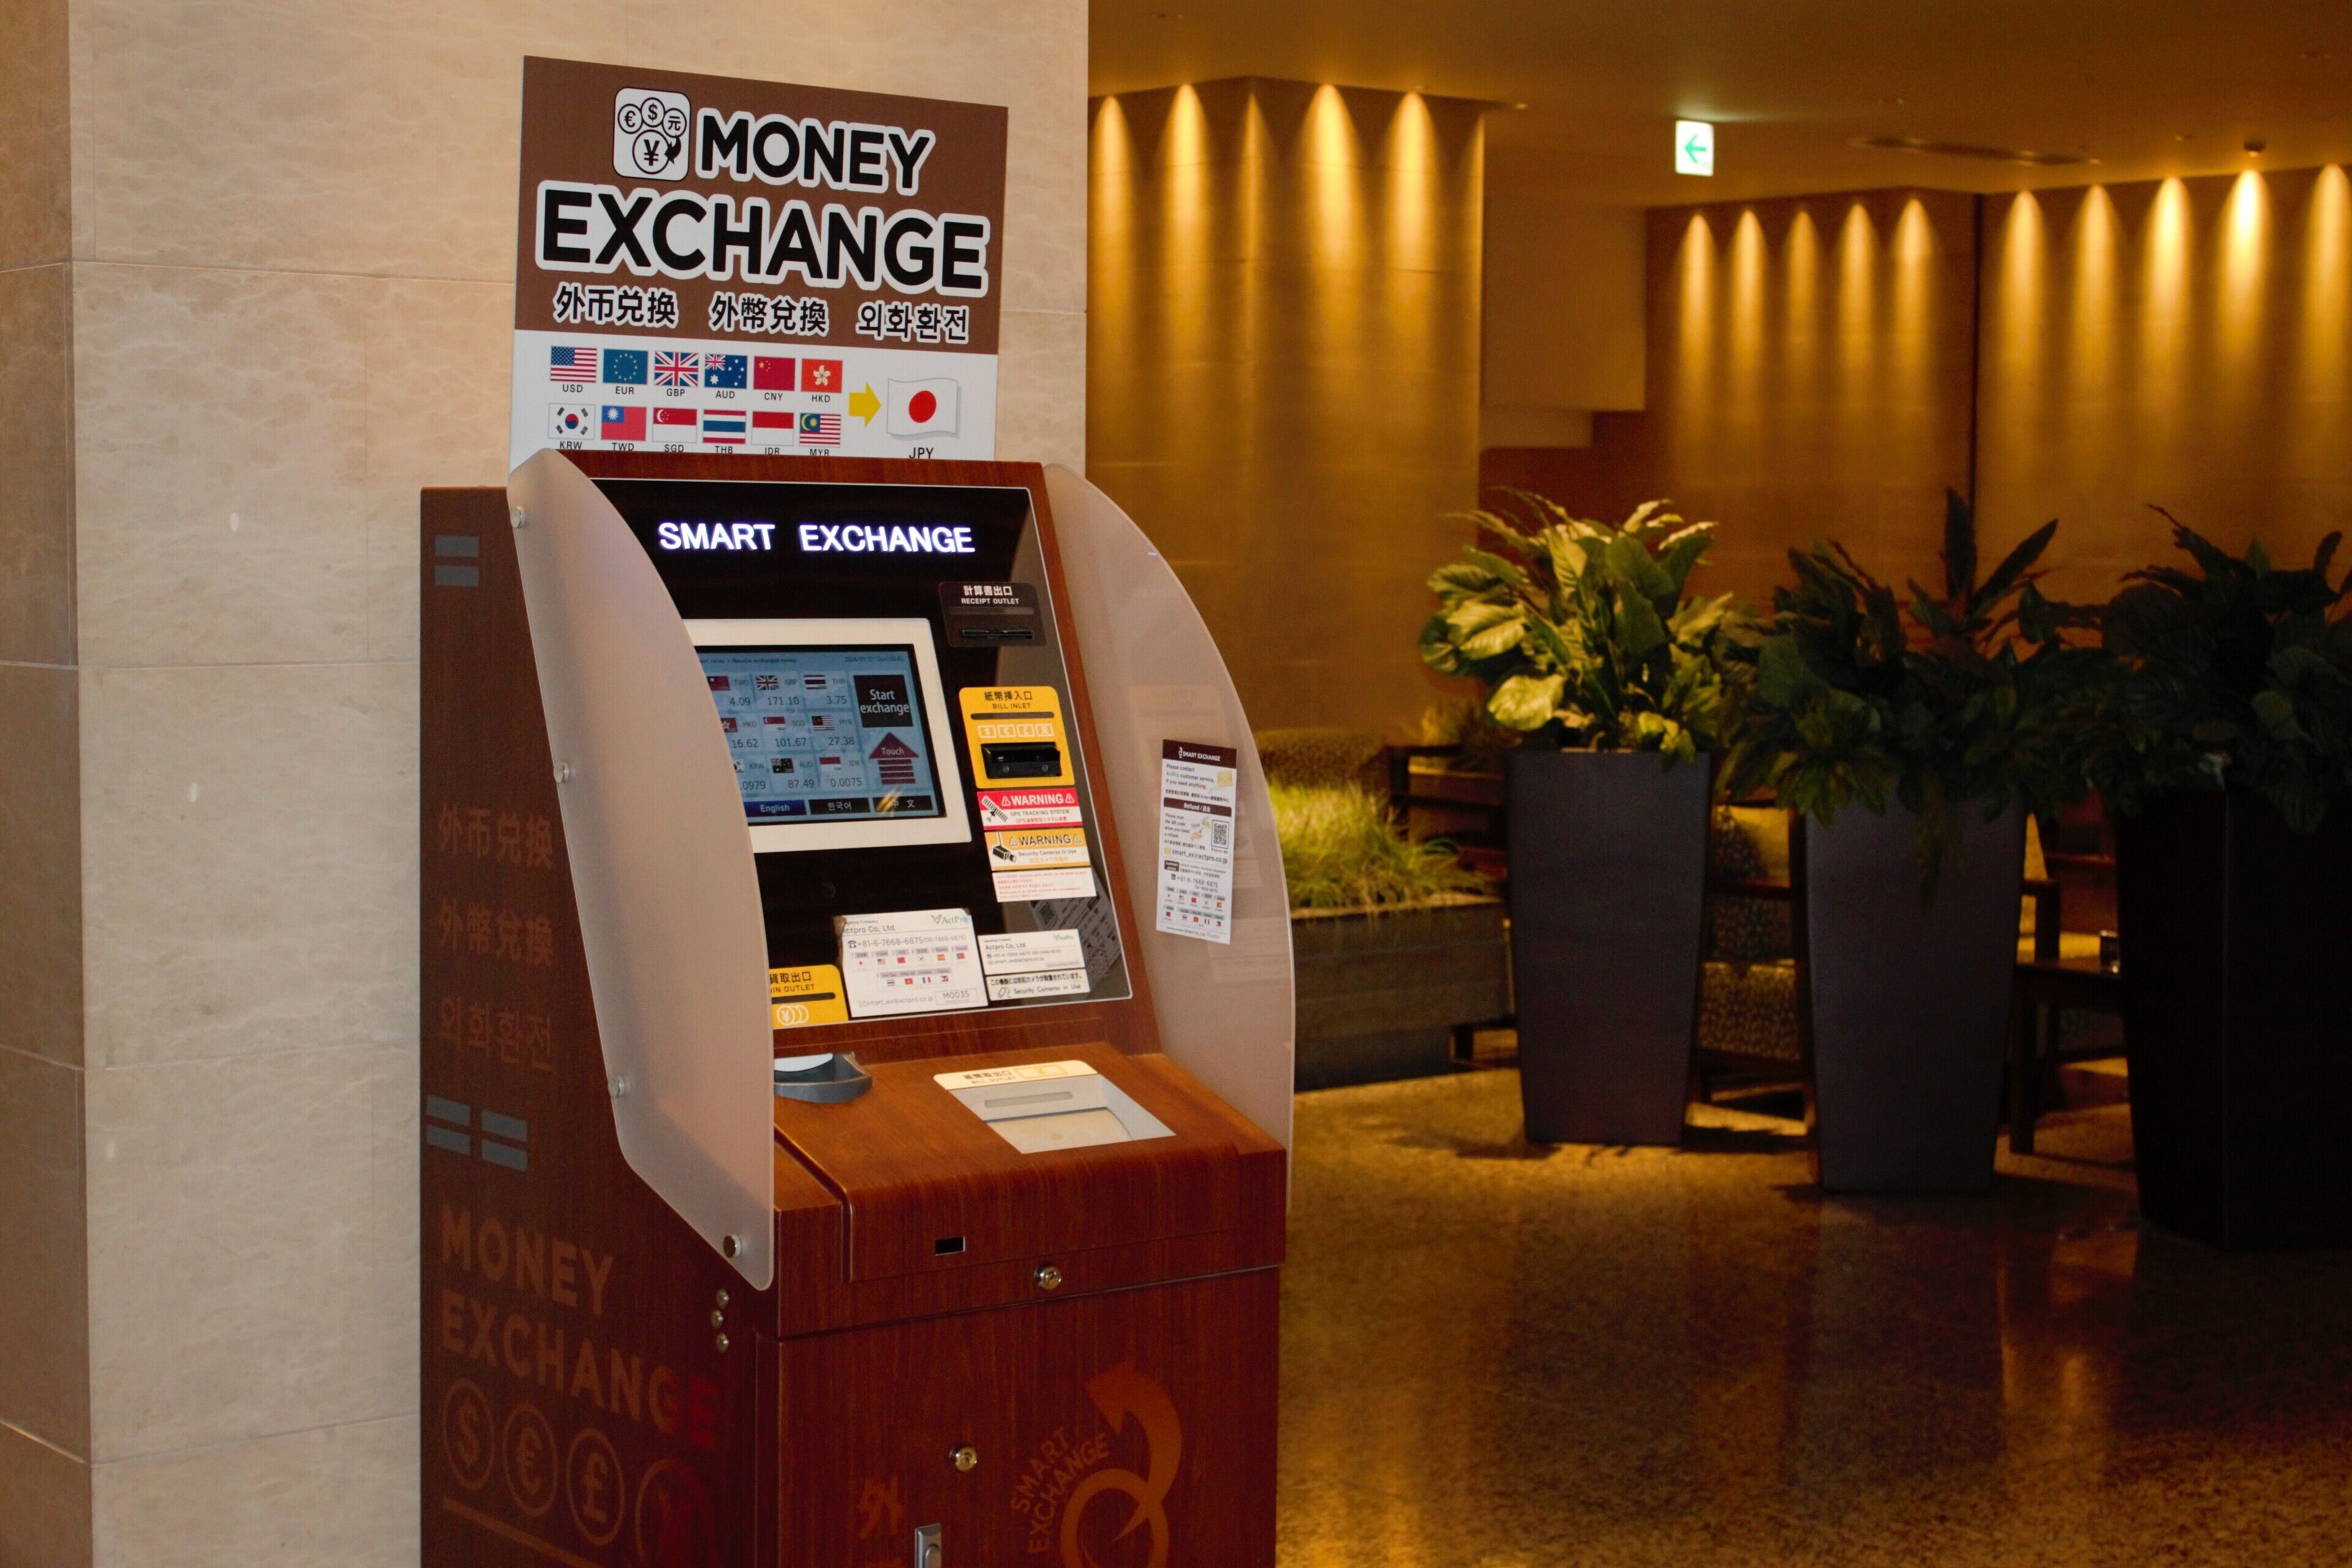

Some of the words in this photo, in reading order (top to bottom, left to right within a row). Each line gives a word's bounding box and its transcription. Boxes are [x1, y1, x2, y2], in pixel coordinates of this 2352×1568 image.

[698, 113, 931, 190] MONEY
[541, 187, 985, 291] EXCHANGE
[557, 285, 676, 326] 外币兑换
[712, 295, 827, 334] 外幣兌換
[858, 304, 967, 341] 외화환전
[562, 384, 583, 393] USD
[615, 386, 634, 395] EUR
[666, 388, 685, 397] GBP
[764, 393, 783, 401] CNY
[559, 441, 582, 450] KRW
[612, 443, 635, 451] TWD
[664, 444, 684, 453] SGD
[764, 447, 780, 456] IDR
[909, 447, 935, 459] JPY
[658, 522, 775, 550] SMART
[798, 524, 976, 553] EXCHANGE
[963, 585, 1012, 596] 計算書出口
[869, 688, 895, 700] Start
[729, 696, 751, 706] 4.09
[767, 696, 800, 706] 171.10
[827, 695, 847, 704] 3.75
[860, 702, 910, 715] exchange
[731, 739, 759, 748] 16.62
[775, 737, 807, 747] 101.67
[829, 736, 855, 746] 27.38
[881, 746, 905, 756] Touch
[1197, 753, 1221, 761] EXCHANGE
[788, 778, 815, 788] 87.49
[831, 777, 862, 787] 0.0075
[1011, 794, 1065, 805] WARNING
[760, 804, 790, 814] English
[827, 802, 853, 811] 한국어
[438, 801, 553, 869] 外币兑换
[1019, 834, 1071, 845] WARNING
[941, 915, 968, 925] ActPro
[784, 984, 815, 992] OUTLET
[943, 990, 970, 1000] M0035
[438, 995, 552, 1072] 외화환전
[440, 1202, 613, 1318] MONEY
[440, 1288, 717, 1451] EXCHANGE
[1010, 1427, 1070, 1513] SMART
[1027, 1432, 1110, 1553] EXCHANGE
